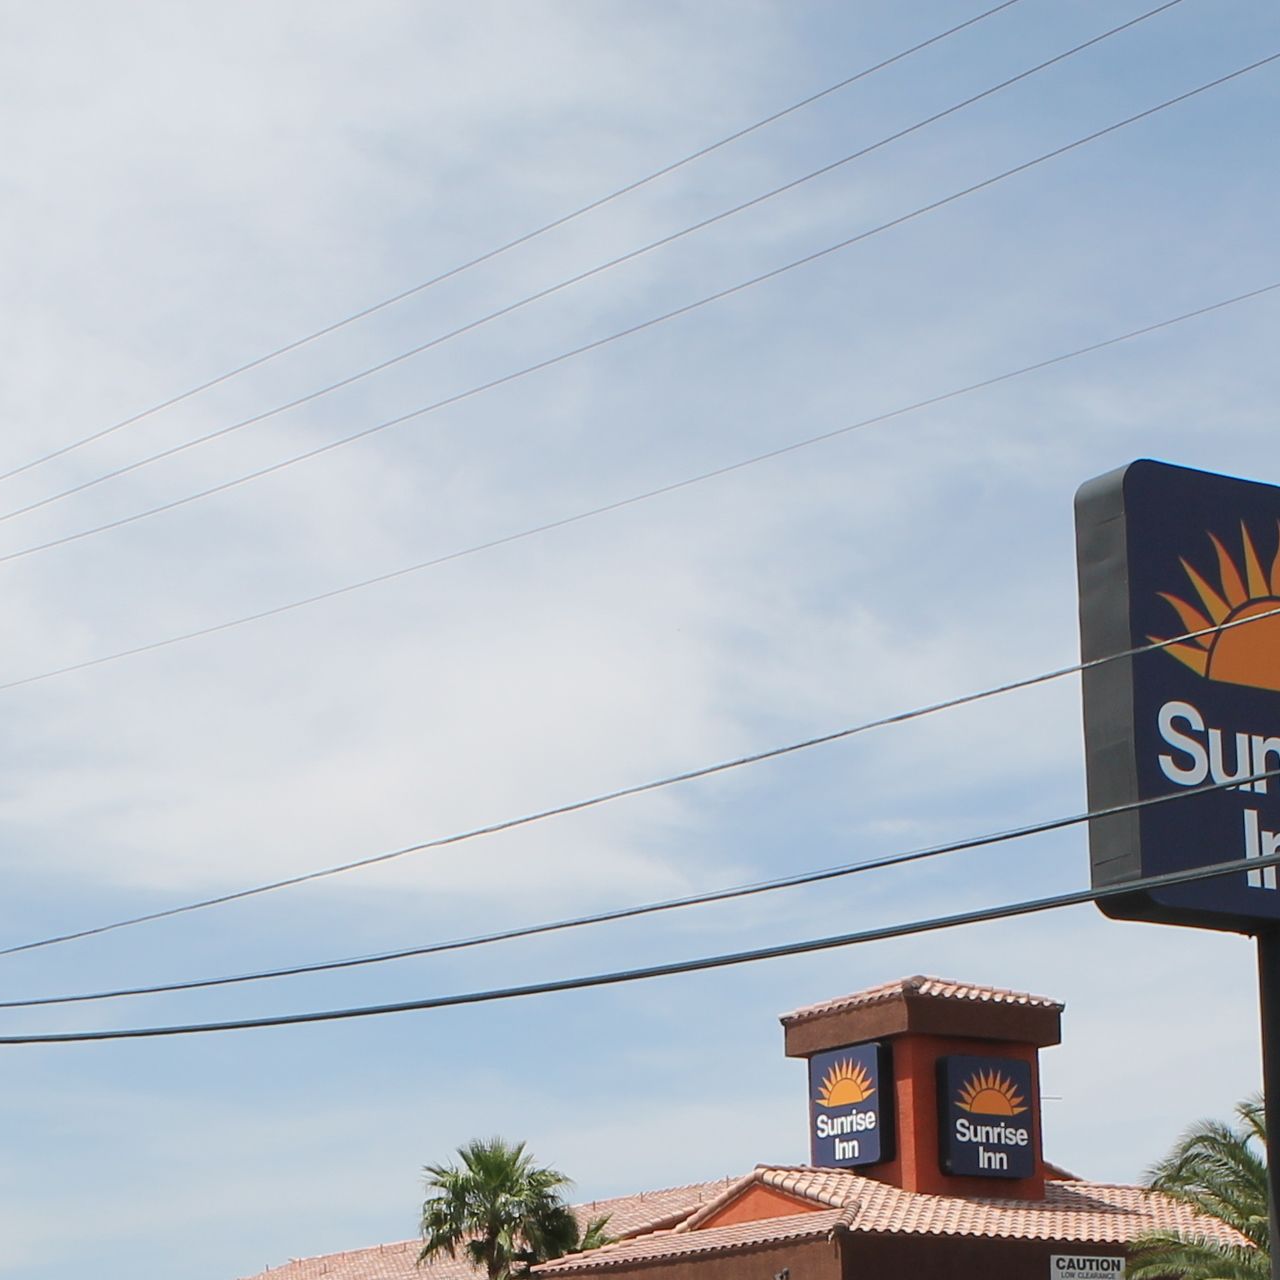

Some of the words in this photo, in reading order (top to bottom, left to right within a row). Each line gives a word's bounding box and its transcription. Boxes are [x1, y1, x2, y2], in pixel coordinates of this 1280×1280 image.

[817, 1109, 876, 1138] Sunrise
[956, 1118, 1028, 1146] Sunrise
[835, 1138, 859, 1160] Inn
[979, 1146, 1007, 1170] Inn
[1056, 1258, 1121, 1271] CAUTION
[1078, 1272, 1116, 1280] CLEARANCE
